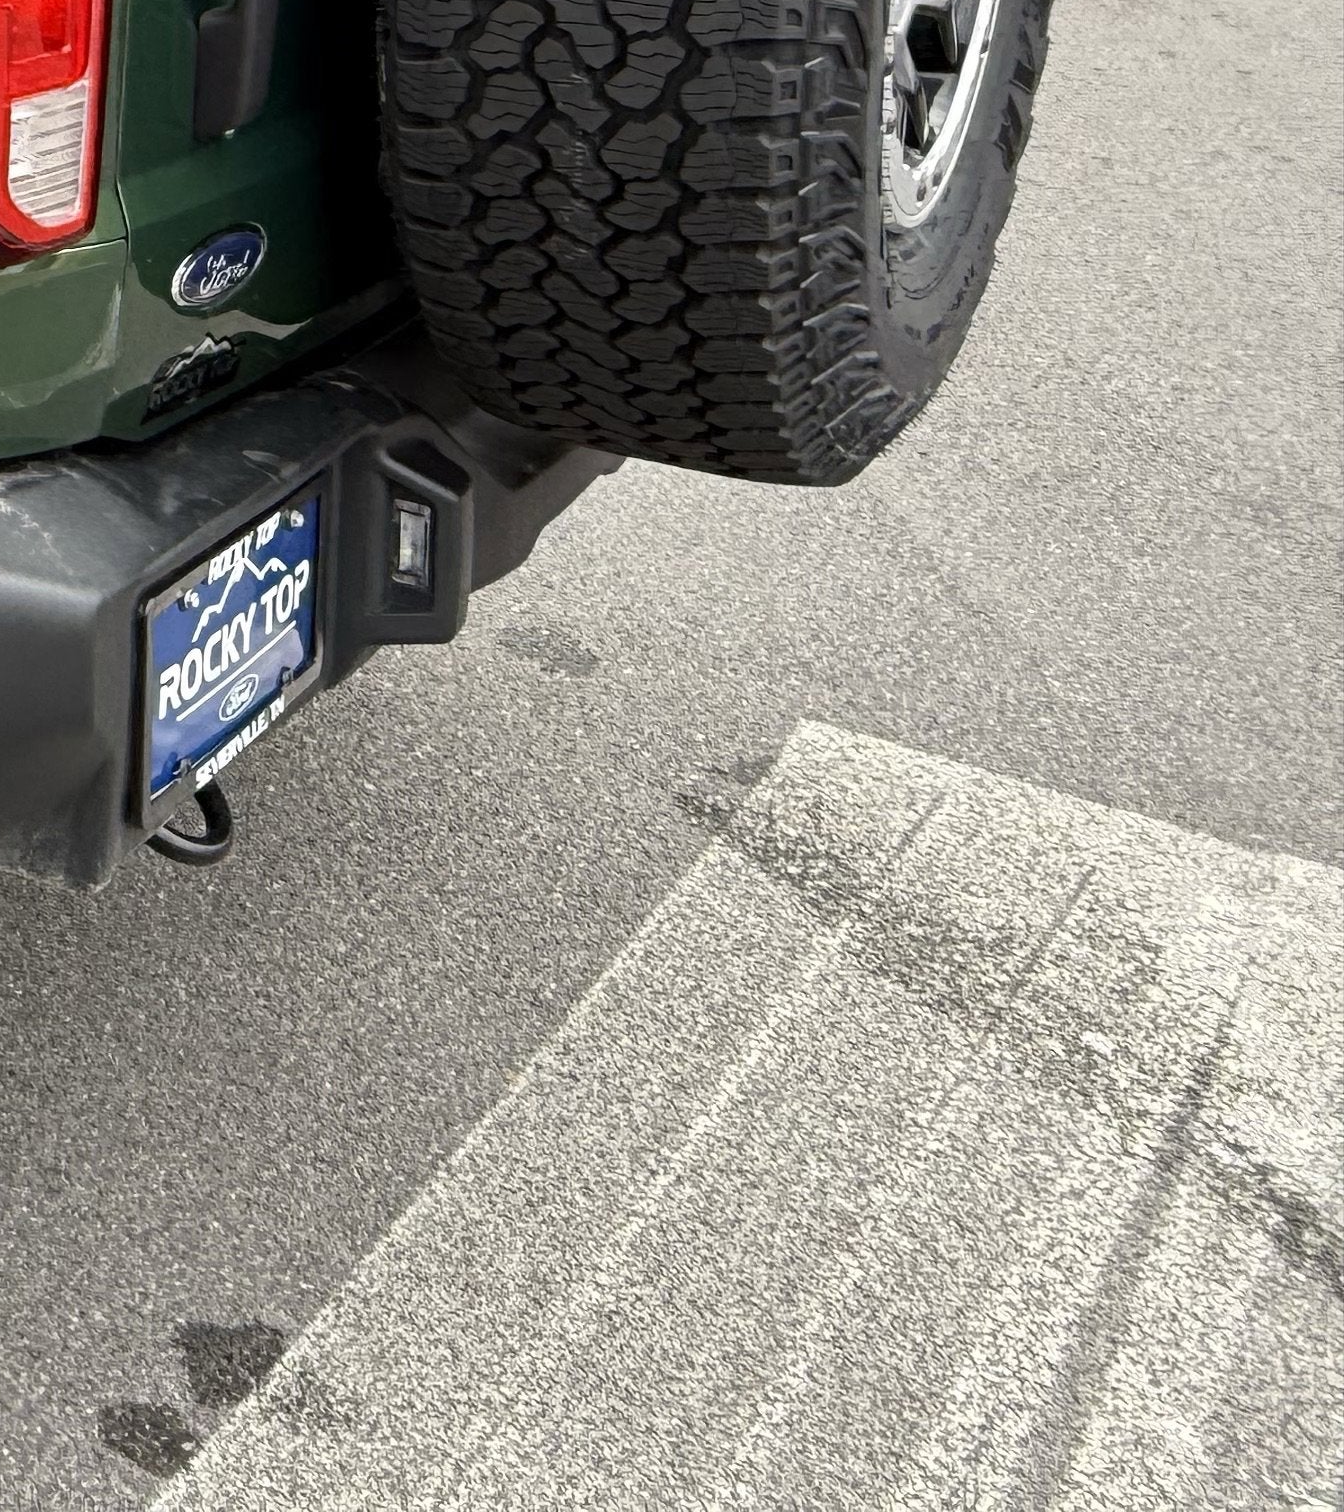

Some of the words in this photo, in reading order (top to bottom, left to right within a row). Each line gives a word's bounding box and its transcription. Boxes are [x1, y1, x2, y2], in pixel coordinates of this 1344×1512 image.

[207, 530, 254, 585] ROCKY
[255, 511, 281, 550] TOP
[159, 602, 257, 720] ROCKY
[261, 559, 310, 636] TOP
